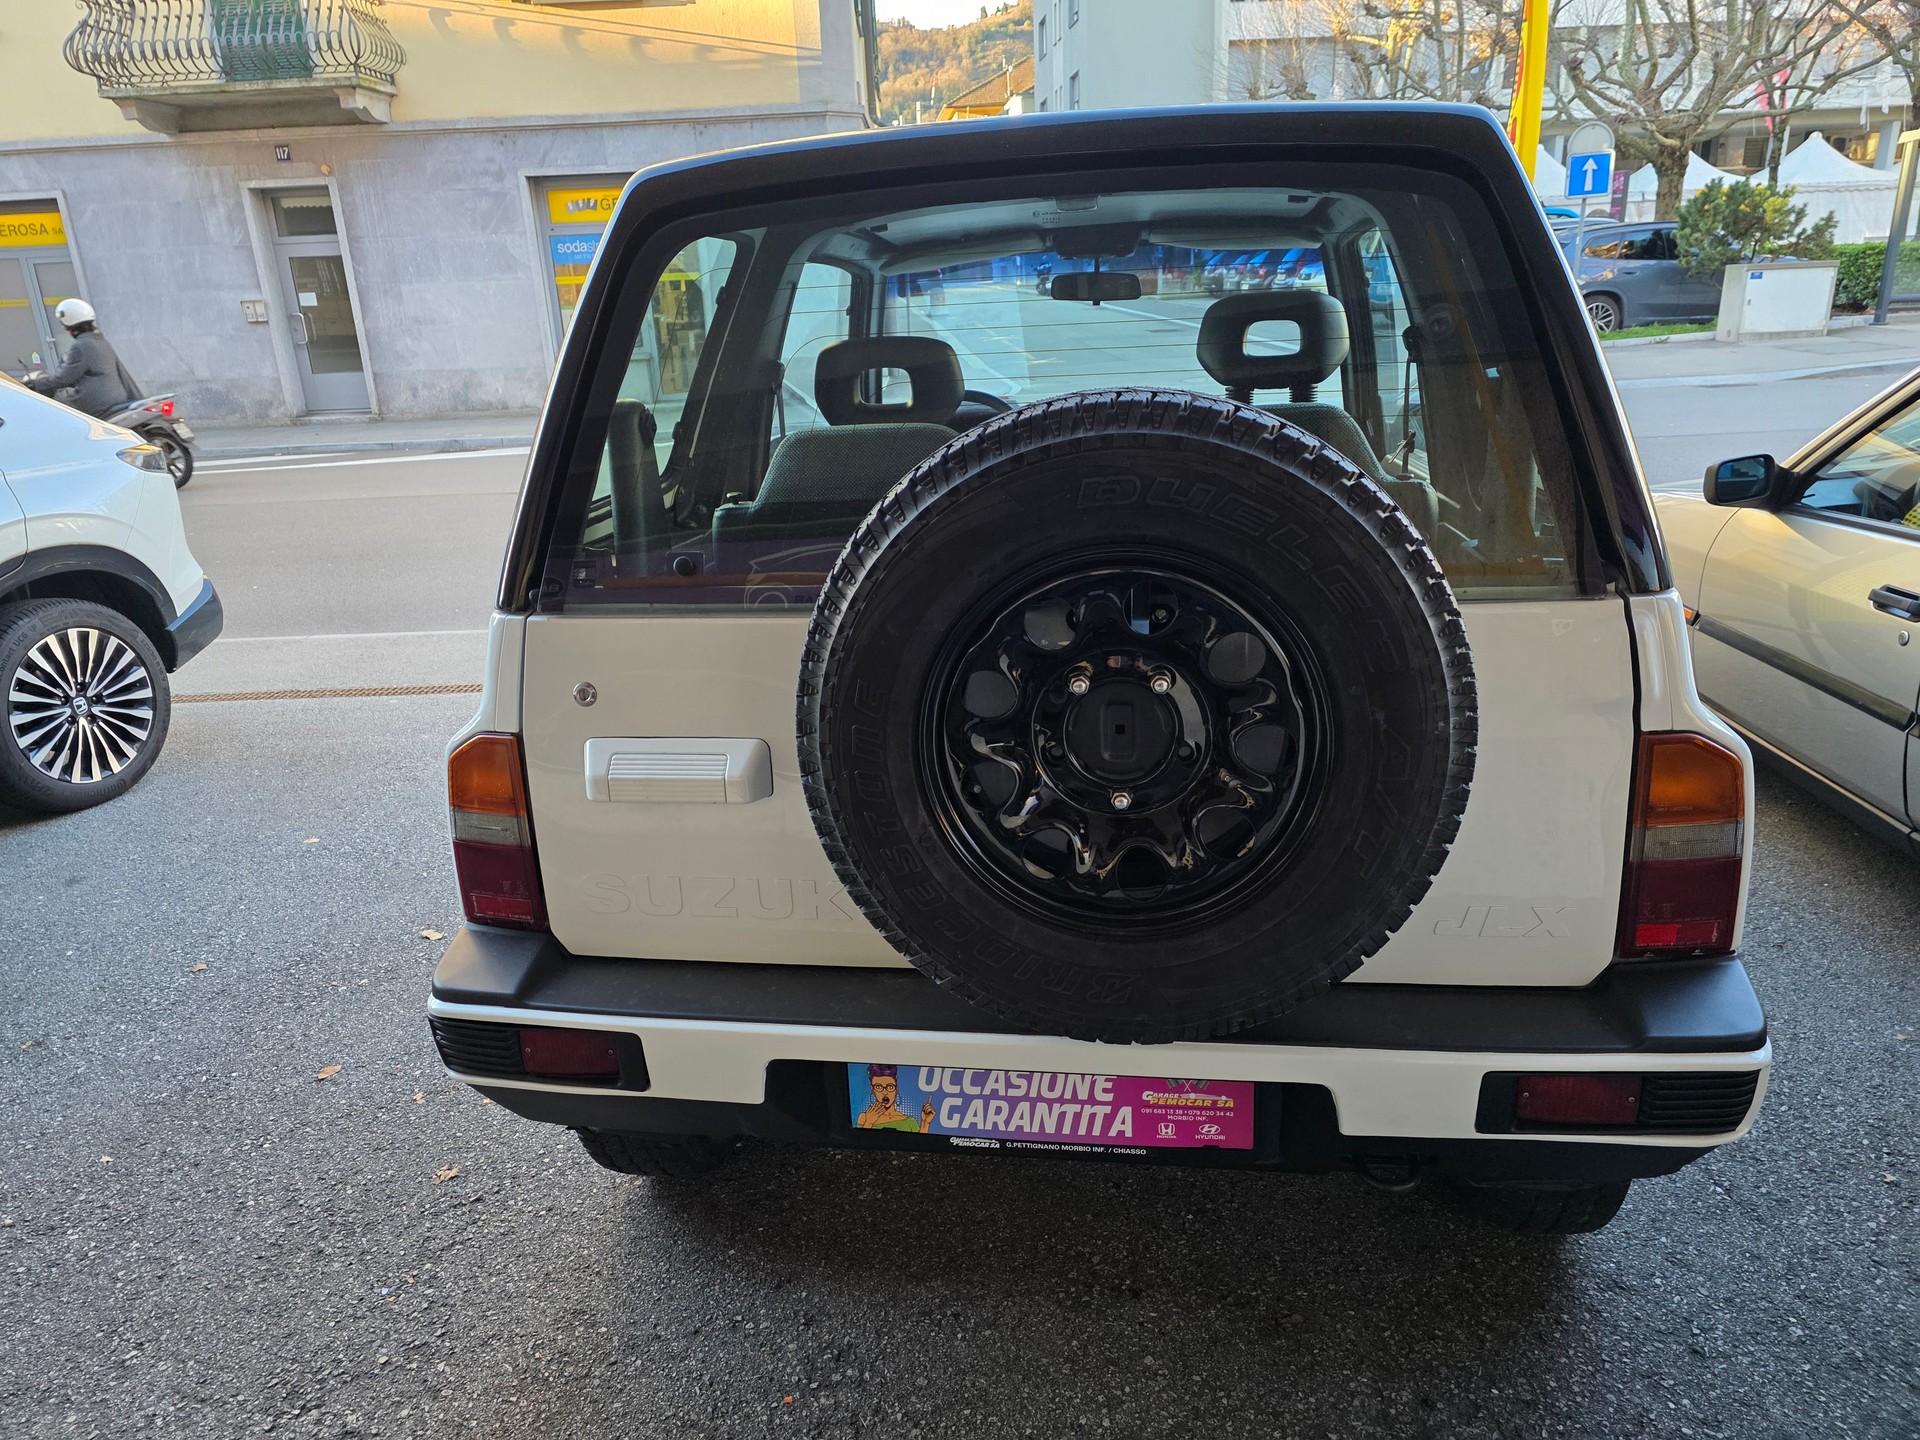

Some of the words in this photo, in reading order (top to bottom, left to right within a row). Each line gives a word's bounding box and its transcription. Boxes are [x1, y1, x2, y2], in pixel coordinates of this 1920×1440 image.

[276, 147, 288, 159] 117
[0, 223, 49, 236] EROSA
[1077, 475, 1401, 674] DUELER
[1433, 905, 1577, 938] JLX
[918, 1066, 1117, 1102] OCCASIONE
[1149, 1098, 1212, 1107] PEMOCAR
[1216, 1099, 1234, 1108] SA
[939, 1097, 1132, 1137] GARANTITA
[1006, 1142, 1060, 1151] G.PETTIGNANO
[1061, 1144, 1091, 1152] MORBIO
[1113, 1147, 1147, 1155] CHIASSO
